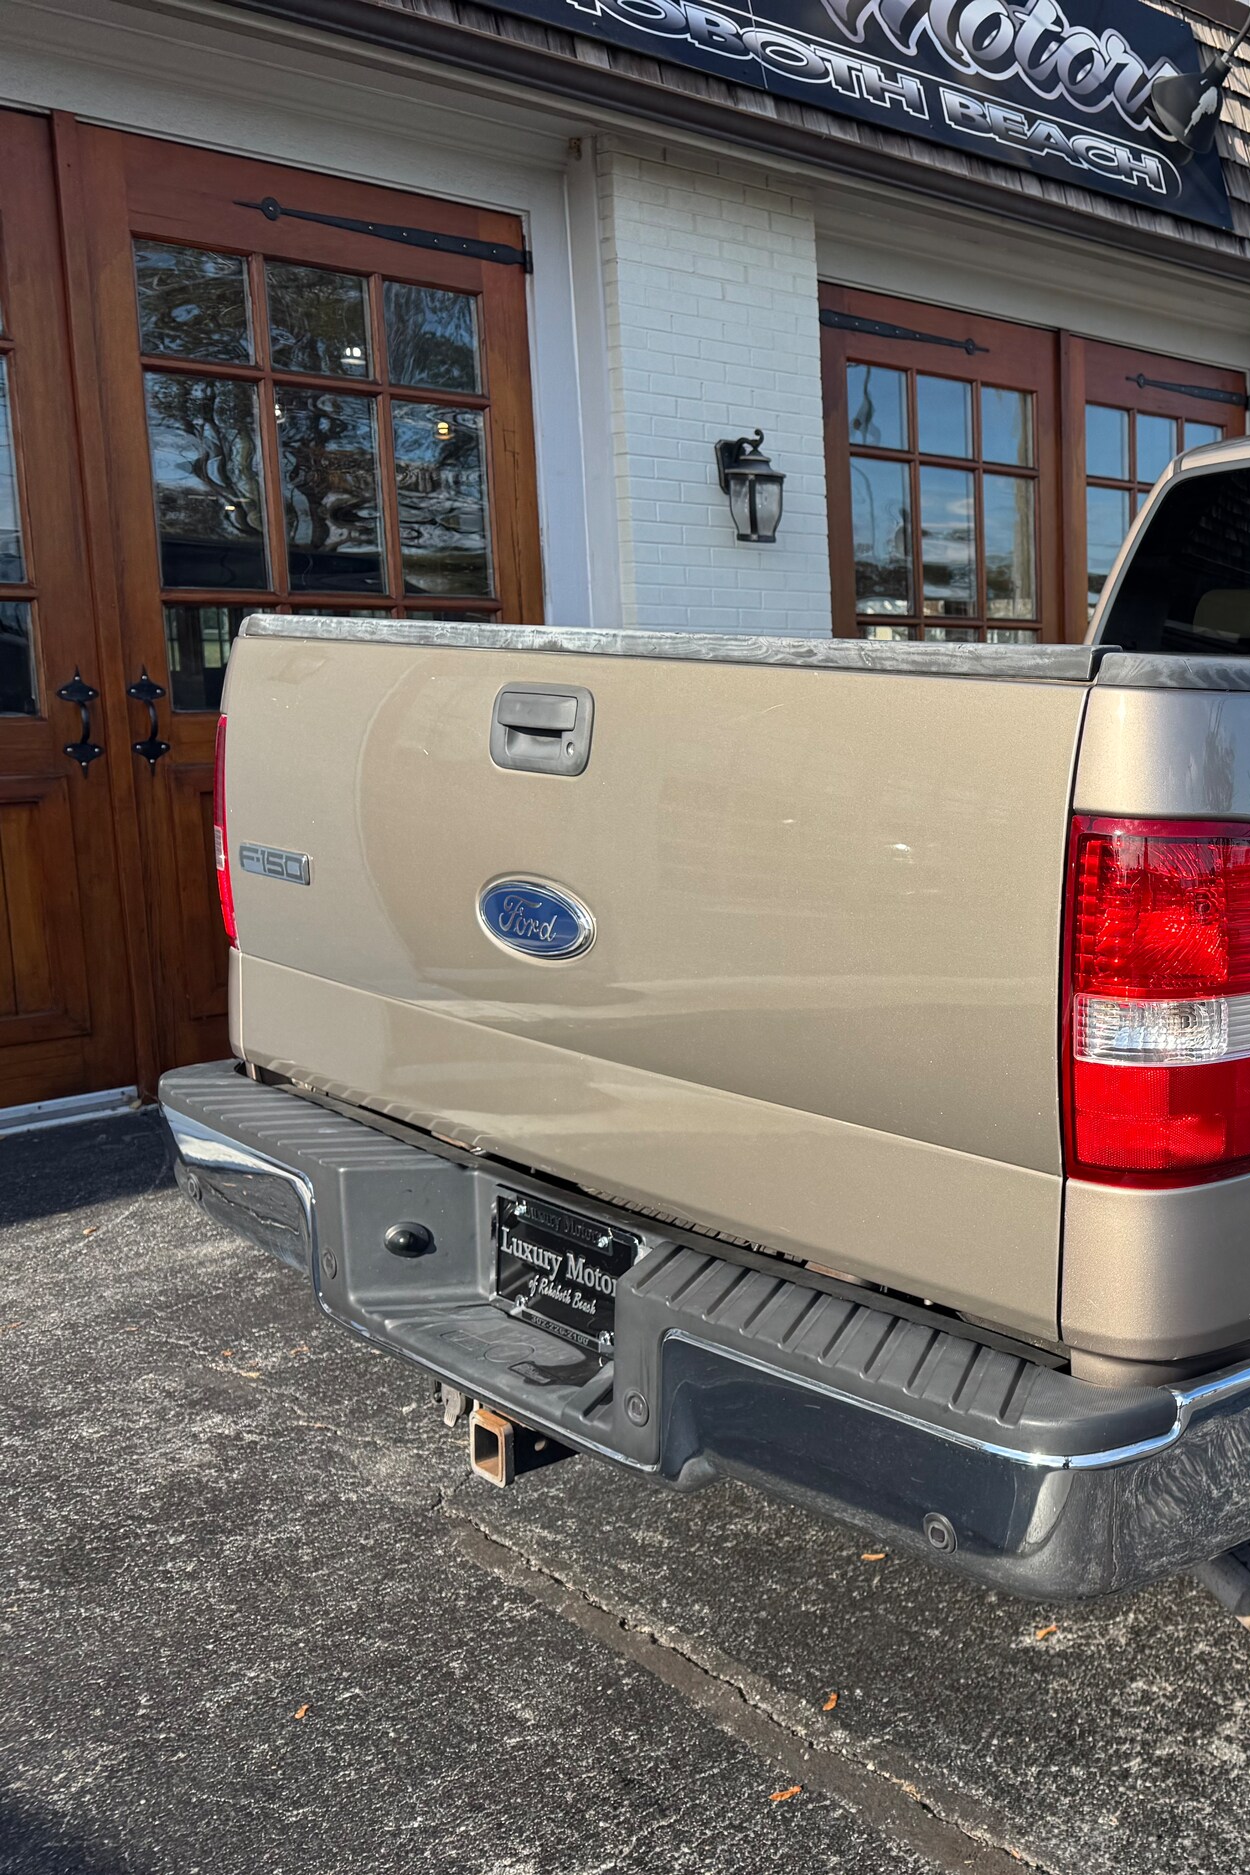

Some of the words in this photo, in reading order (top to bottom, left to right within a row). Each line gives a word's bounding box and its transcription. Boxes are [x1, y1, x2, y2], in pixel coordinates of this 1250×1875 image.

[566, 0, 930, 119] OBOTH
[940, 88, 1166, 194] BEACH
[239, 845, 305, 882] F-150
[499, 894, 557, 942] Ford
[501, 1227, 563, 1281] Luxury
[528, 1274, 540, 1297] of
[539, 1279, 572, 1304] Rehoboth
[572, 1291, 598, 1316] Beach
